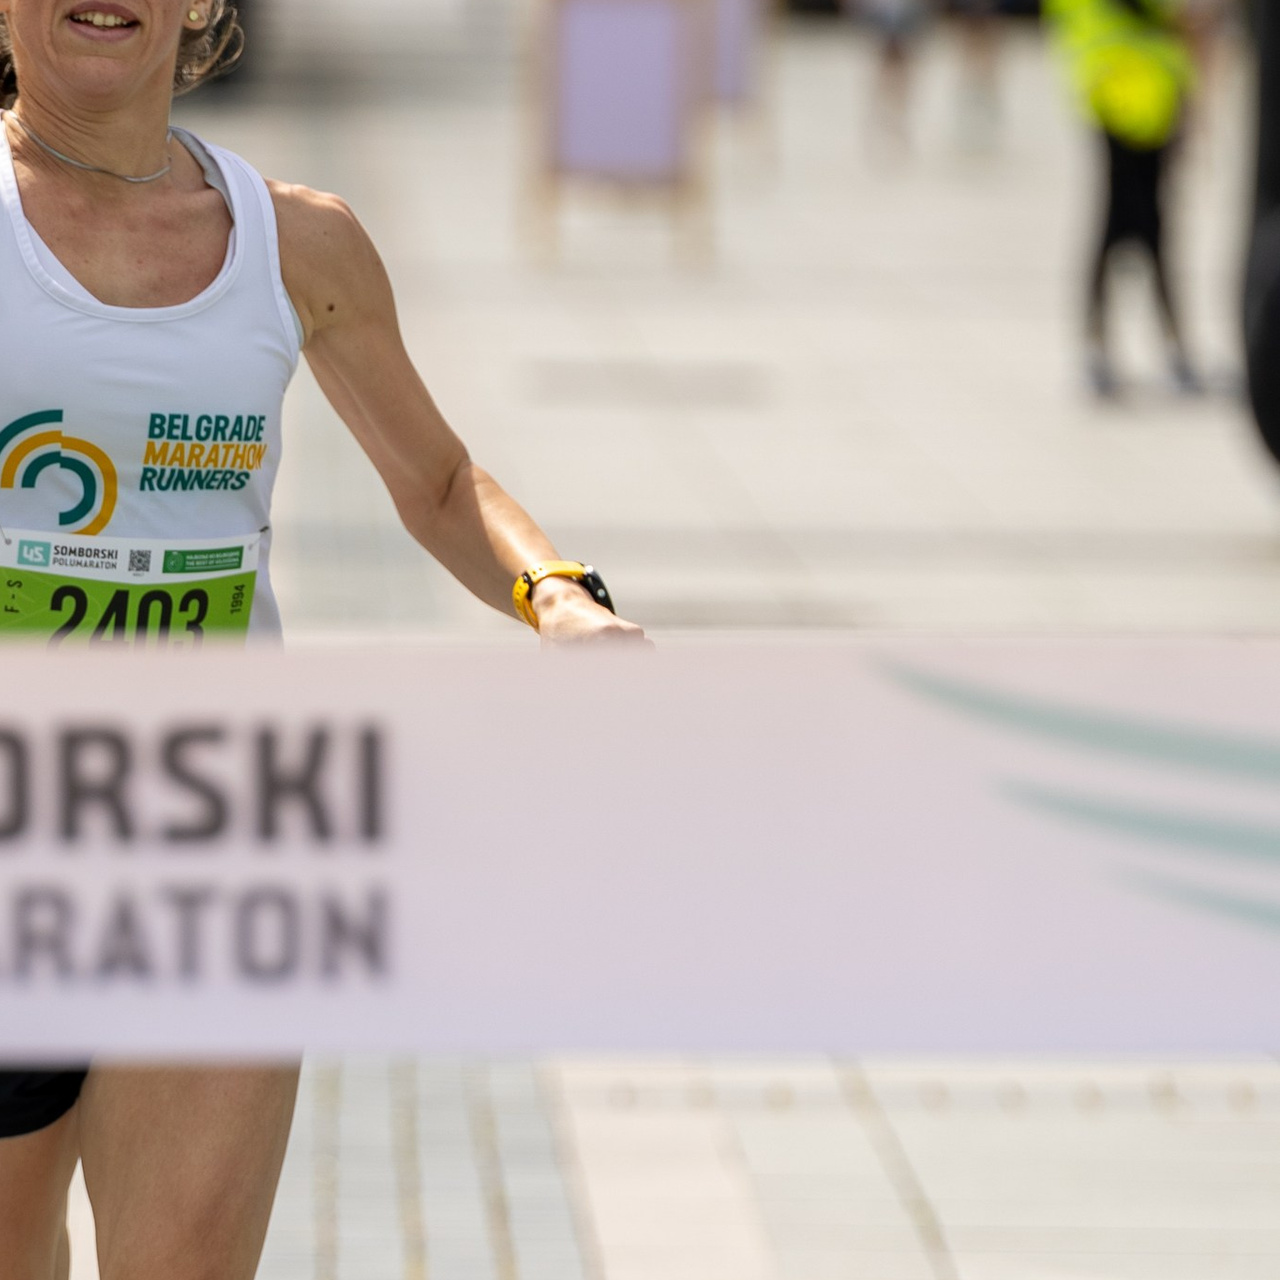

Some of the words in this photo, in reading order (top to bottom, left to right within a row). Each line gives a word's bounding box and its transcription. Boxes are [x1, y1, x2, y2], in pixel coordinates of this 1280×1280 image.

[148, 413, 266, 441] BELGRADE
[143, 441, 267, 470] MARATHON
[139, 467, 250, 491] RUNNERS
[52, 556, 118, 570] POLUMARATON
[53, 545, 118, 560] SOMBORSKI
[230, 584, 246, 615] 1994
[48, 585, 209, 652] 2403
